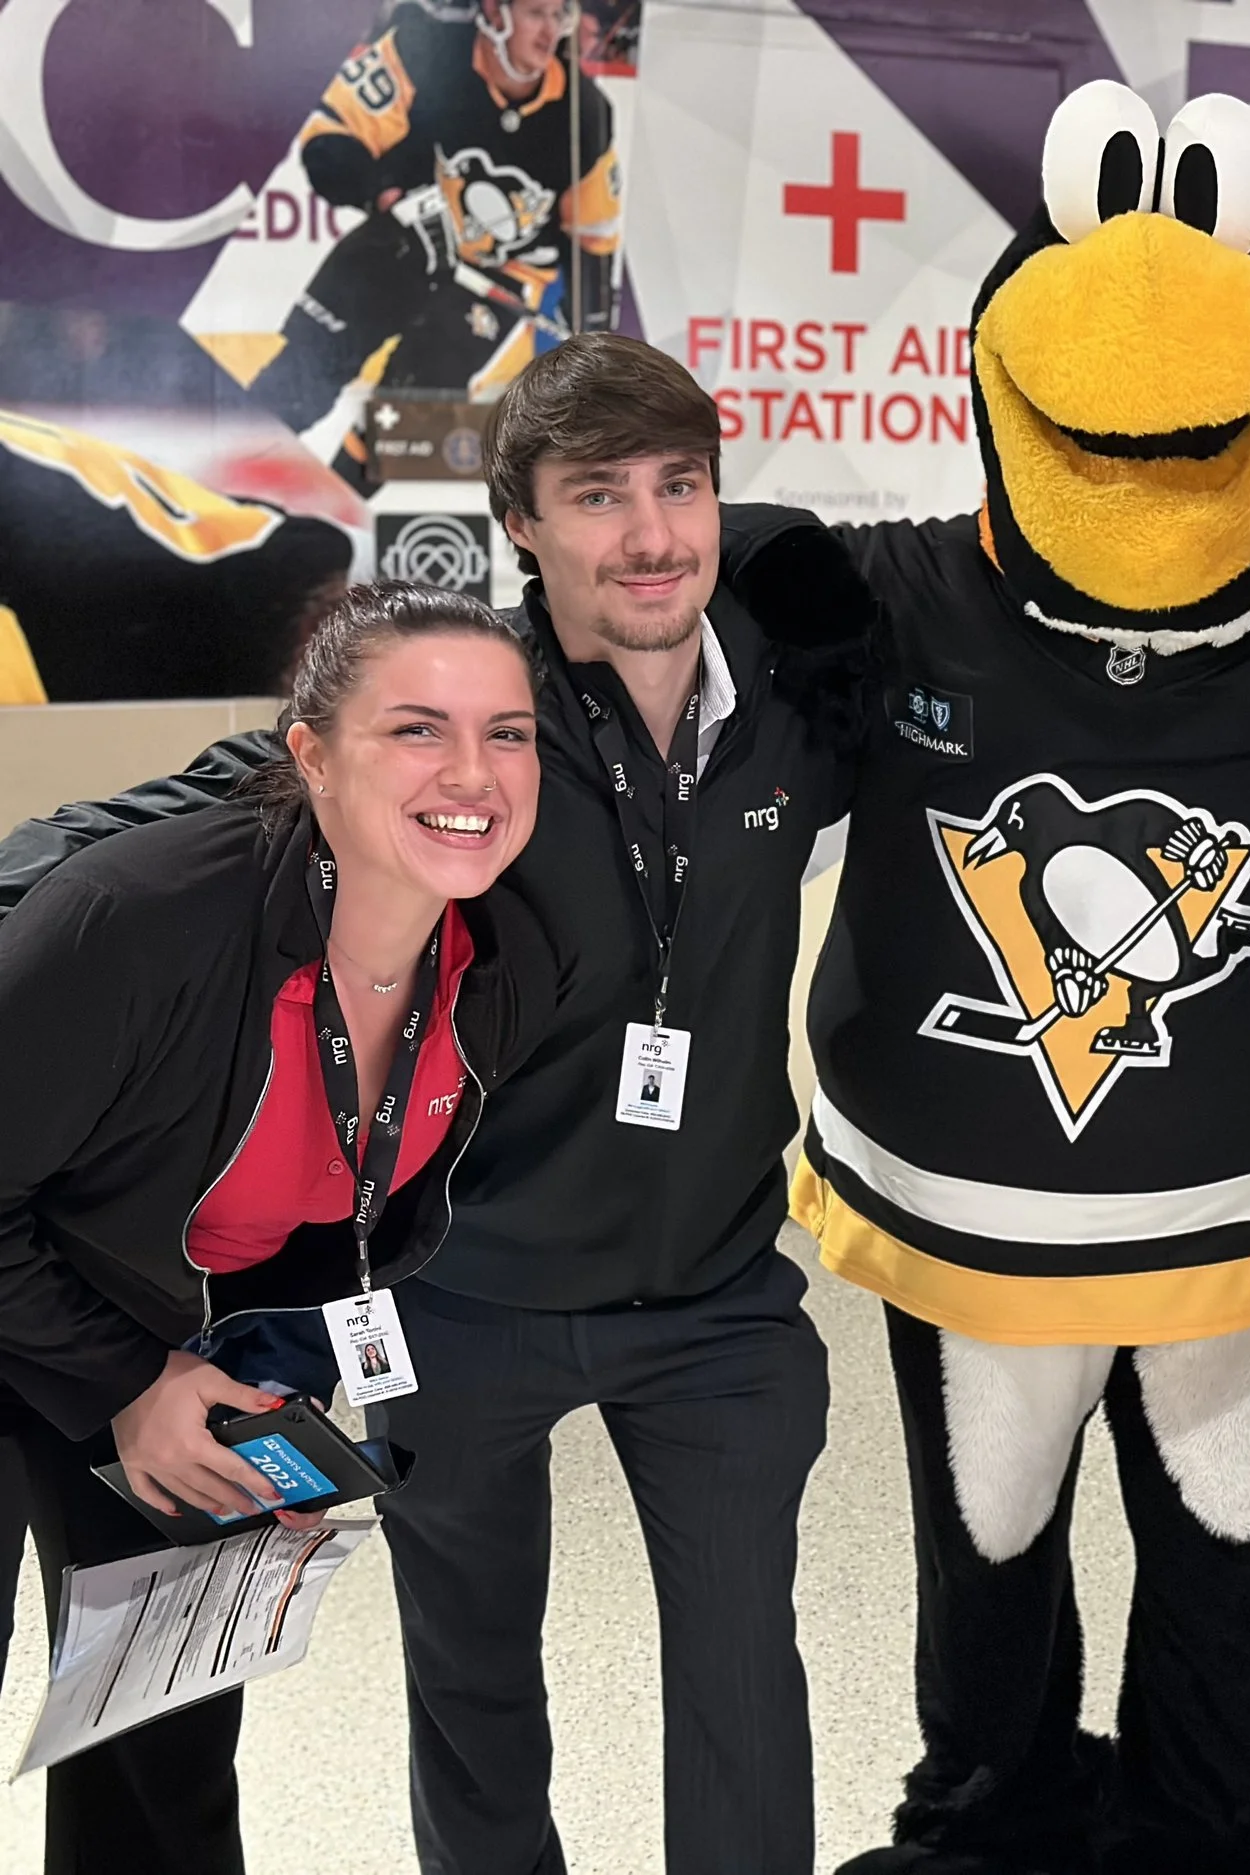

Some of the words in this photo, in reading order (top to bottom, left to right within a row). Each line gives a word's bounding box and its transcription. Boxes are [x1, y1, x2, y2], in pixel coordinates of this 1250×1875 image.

[688, 317, 867, 374] FIRST
[714, 388, 968, 444] STATION
[1115, 657, 1138, 673] NHL
[582, 693, 601, 719] nrg
[686, 694, 699, 720] nrg
[613, 763, 627, 793] nrg
[678, 773, 694, 801] nrg
[744, 806, 779, 830] nrg
[631, 843, 645, 872] nrg
[674, 855, 689, 883] nrg
[320, 860, 335, 890] nrg
[404, 1010, 420, 1040] nrg
[332, 1036, 348, 1065] nrg
[642, 1043, 662, 1056] nrg
[376, 1095, 396, 1125] nrg
[346, 1116, 358, 1145] nrg
[346, 1315, 369, 1327] nrg
[249, 1455, 298, 1489] 2023
